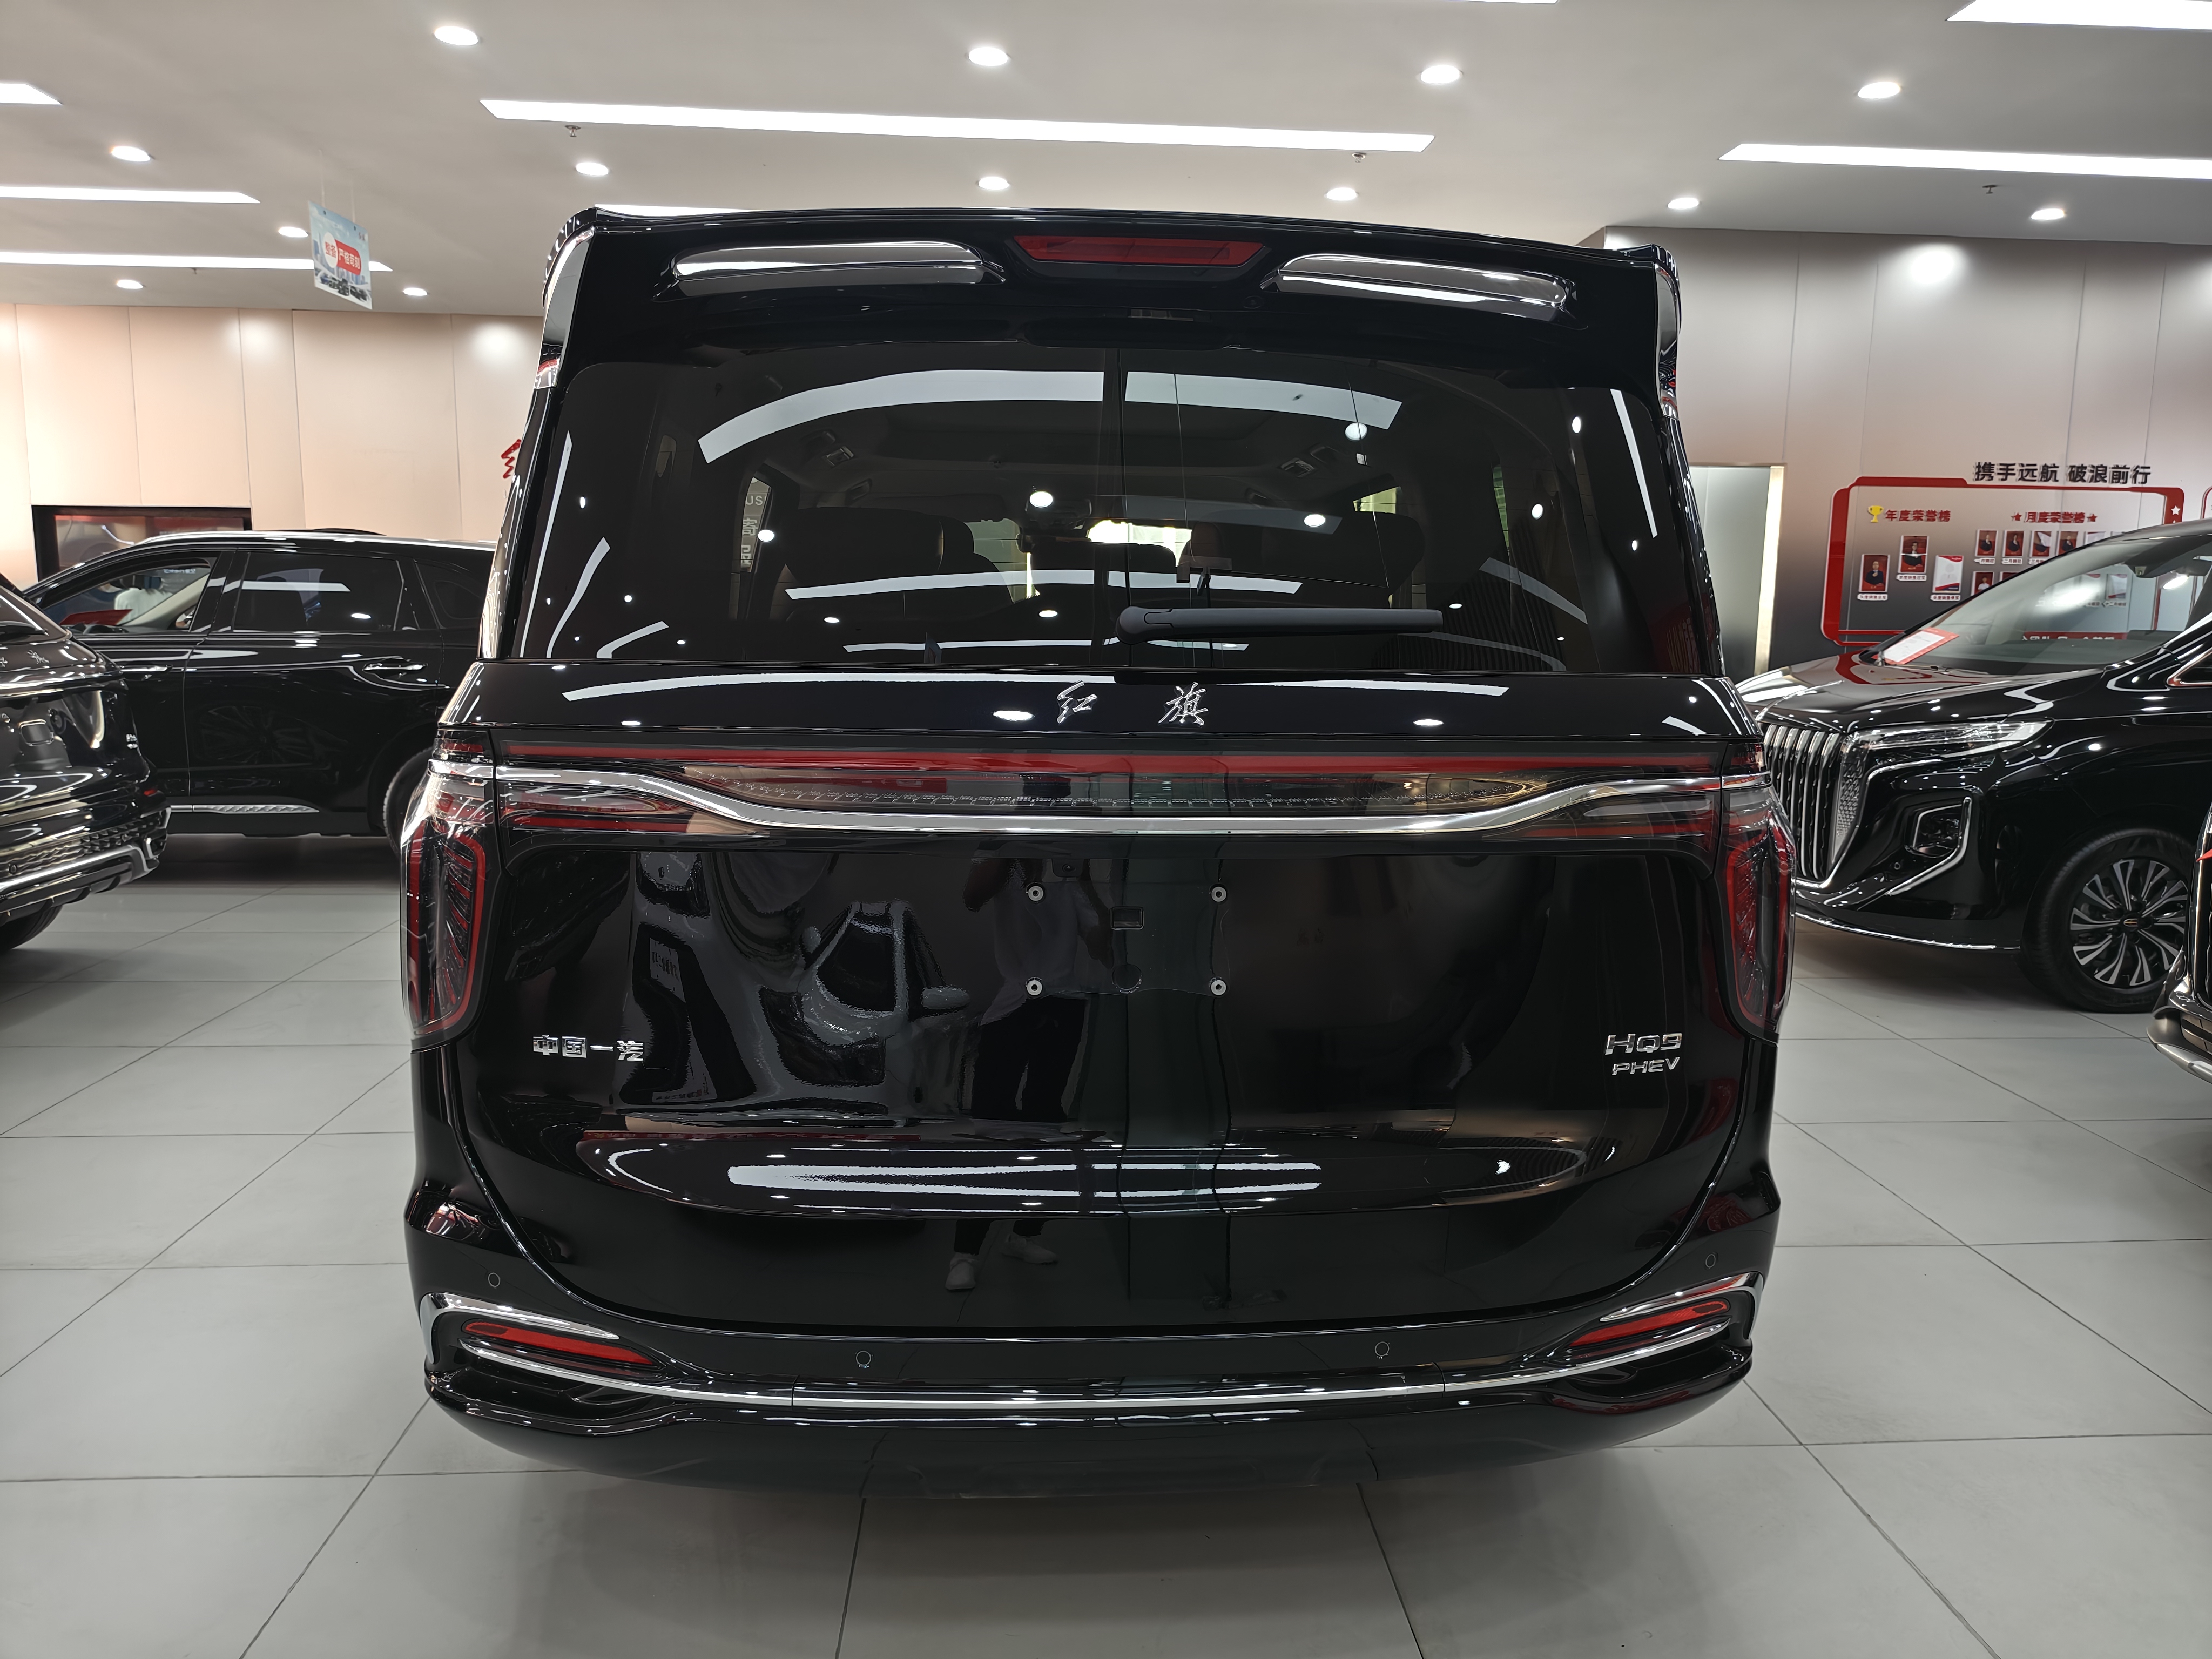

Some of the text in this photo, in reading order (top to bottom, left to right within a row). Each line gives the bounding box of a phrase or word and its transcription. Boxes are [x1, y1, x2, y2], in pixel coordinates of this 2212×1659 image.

[1974, 462, 2151, 484] 携手远航 破浪前行
[1885, 510, 1951, 522] 年度荣誉榜
[2025, 511, 2085, 523] 月度荣誉榜
[533, 1035, 644, 1062] 中国一汽
[1604, 1033, 1682, 1055] HQ9
[1611, 1056, 1681, 1076] PHEV
